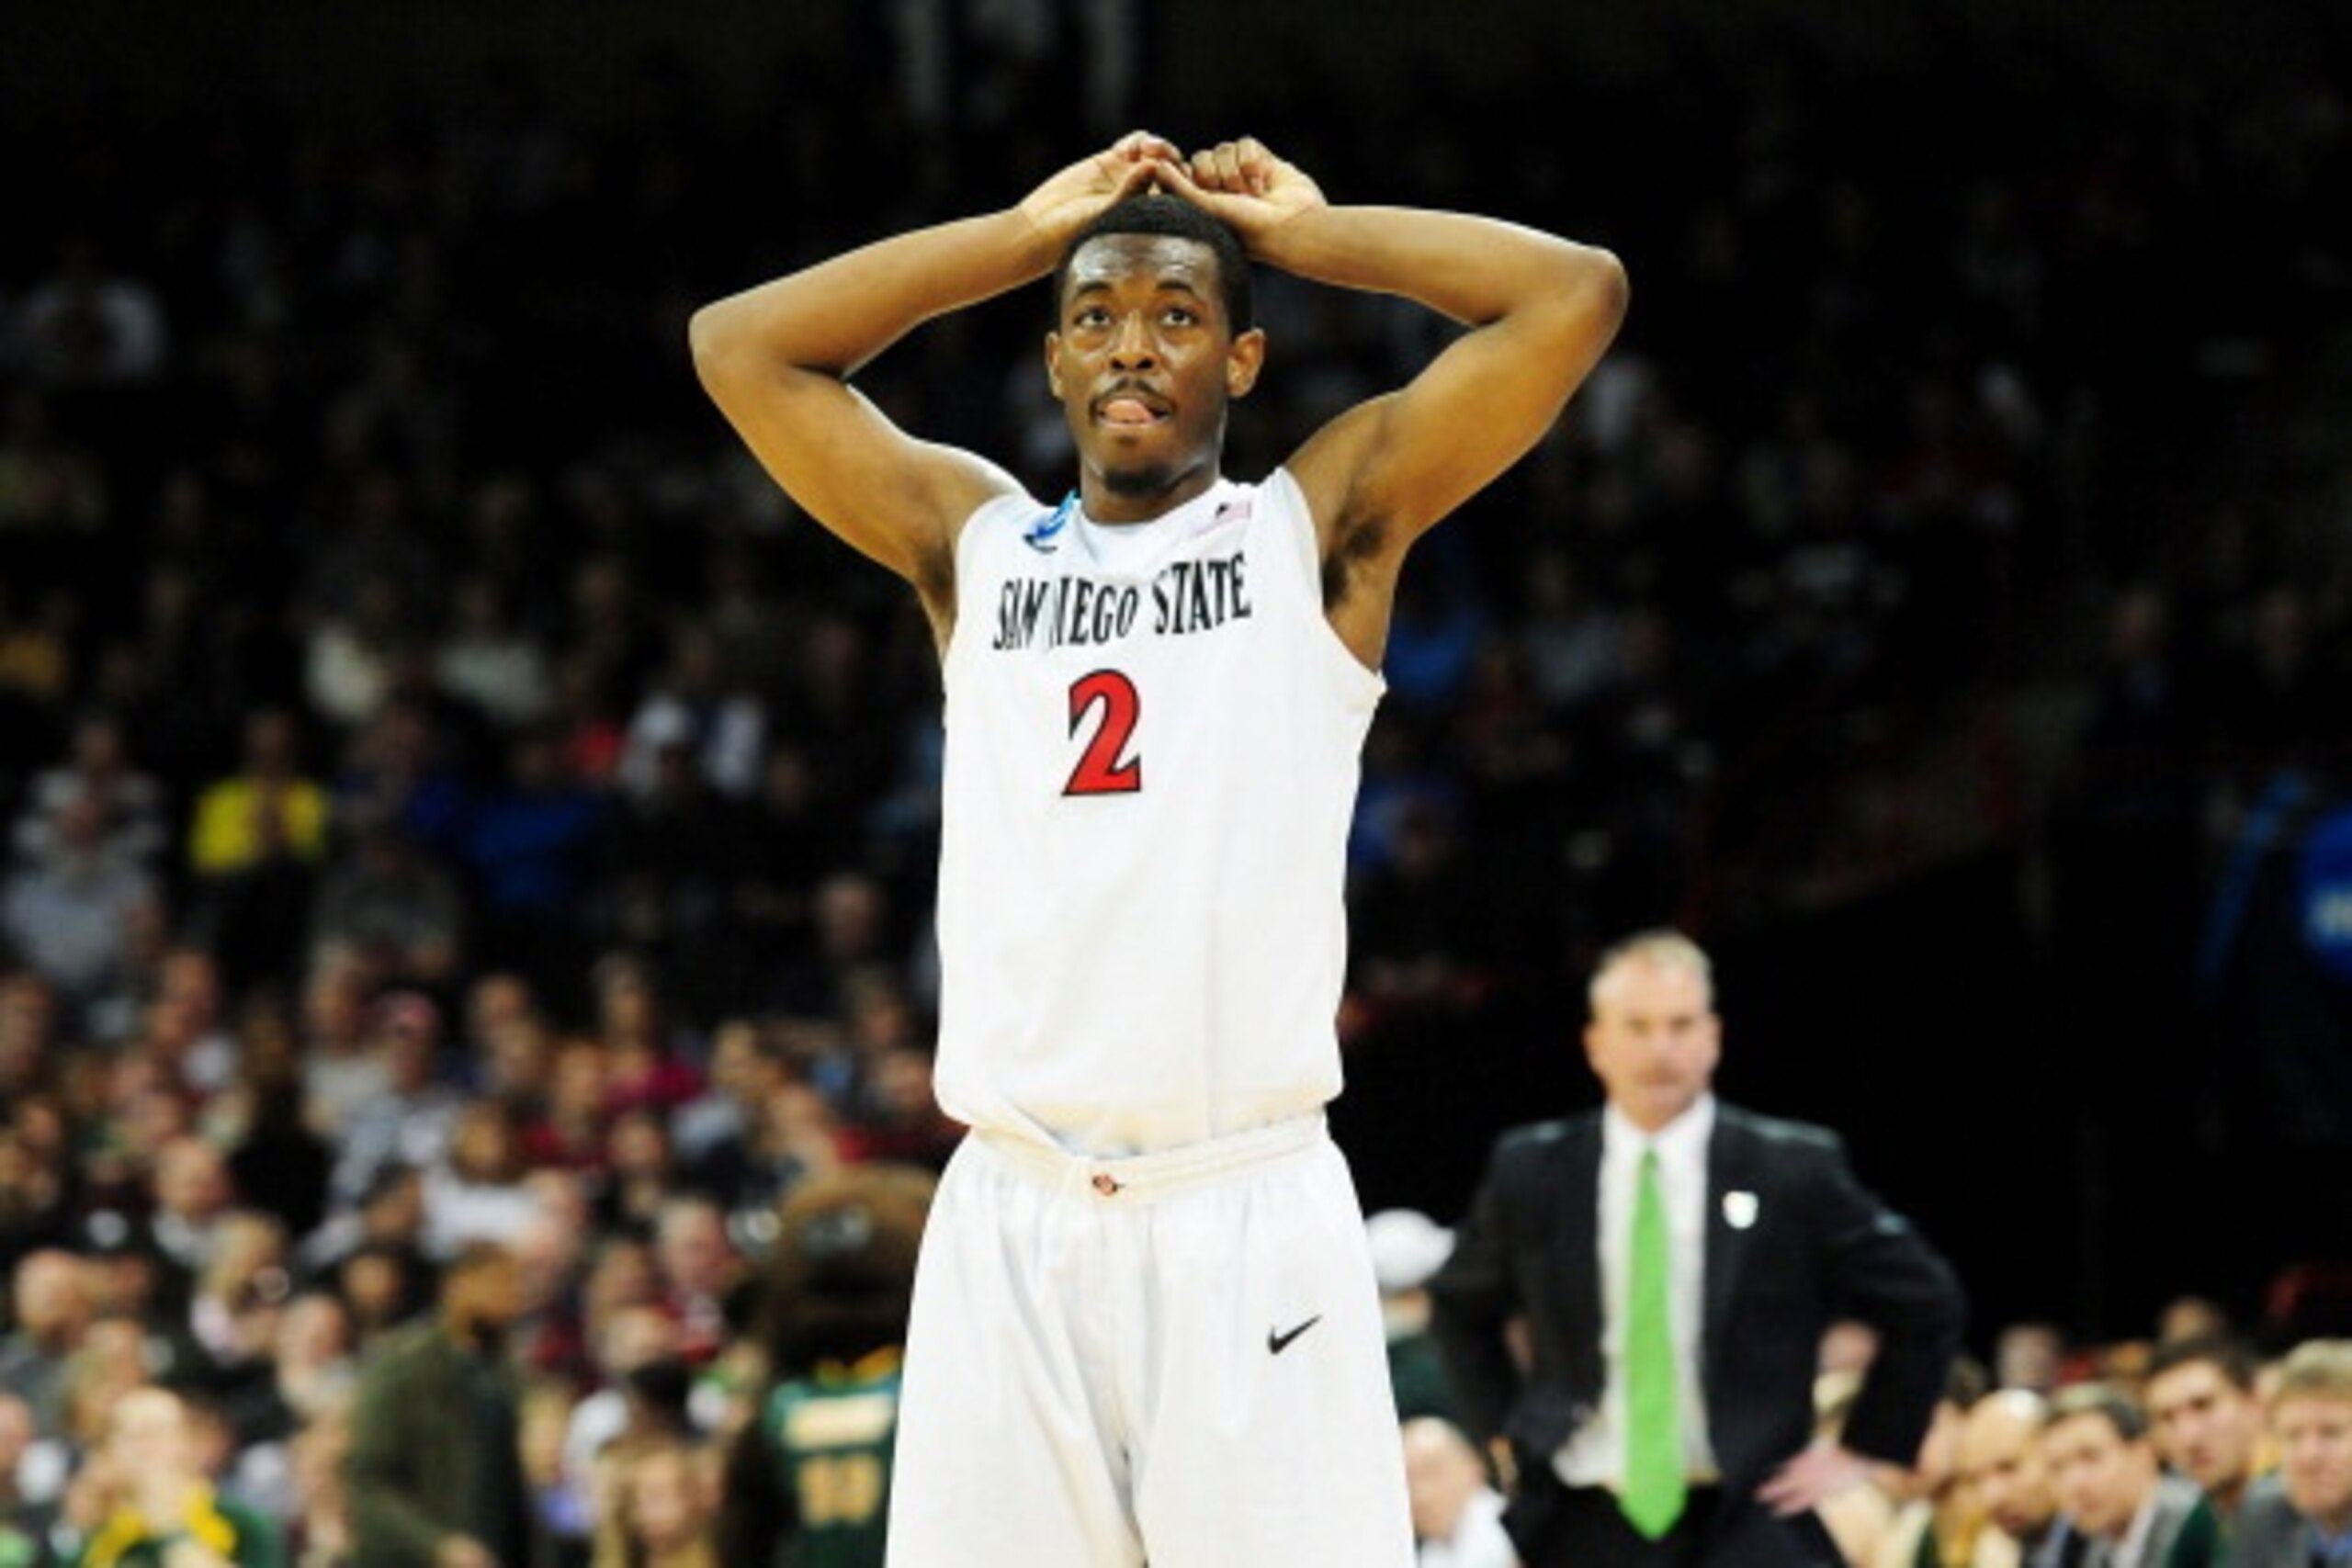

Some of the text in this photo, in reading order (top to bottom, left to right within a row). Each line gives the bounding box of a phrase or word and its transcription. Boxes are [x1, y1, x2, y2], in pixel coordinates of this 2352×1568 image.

[1049, 574, 1139, 649] IEGO
[1152, 550, 1251, 635] STATE
[1061, 668, 1141, 796] 2
